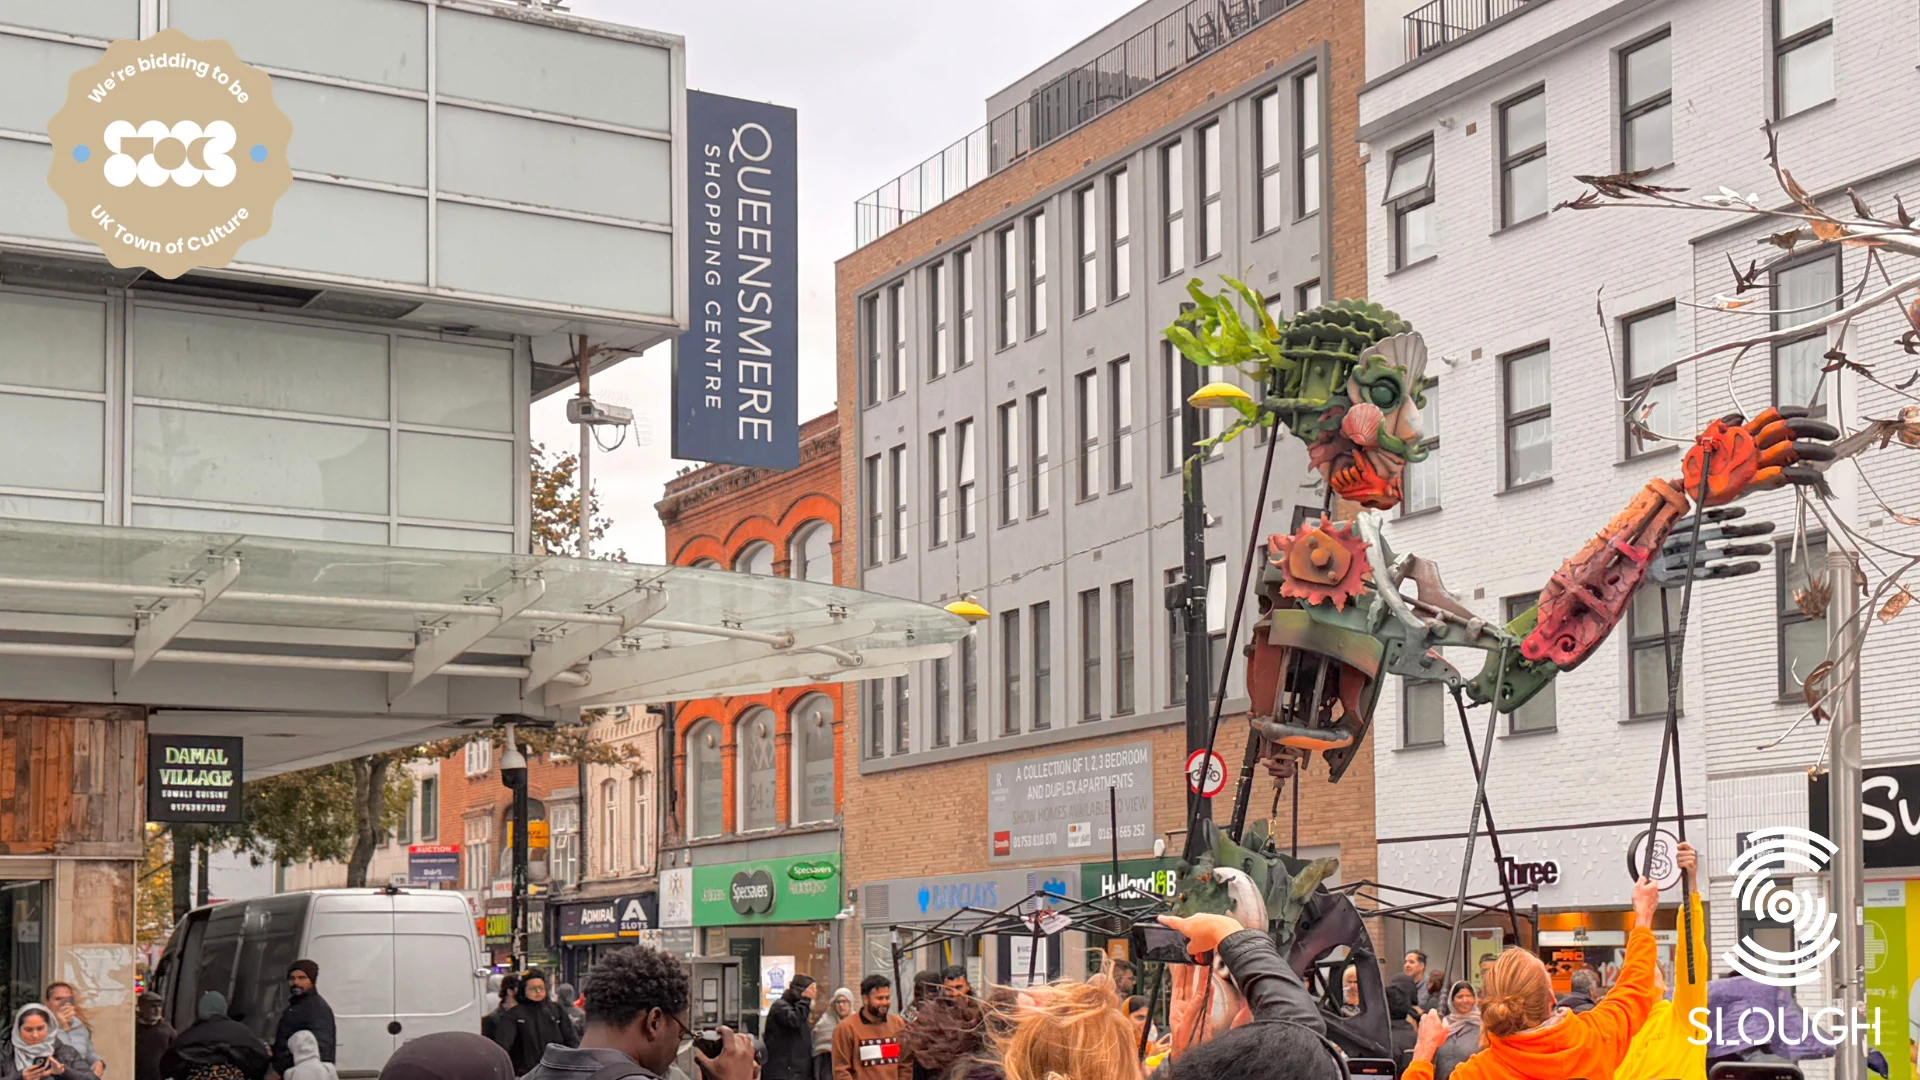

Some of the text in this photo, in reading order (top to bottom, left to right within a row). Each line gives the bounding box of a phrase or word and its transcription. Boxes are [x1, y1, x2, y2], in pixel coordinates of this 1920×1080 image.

[704, 144, 722, 409] SHOPPING CENTRE
[729, 122, 773, 443] QUEENSMERE
[165, 747, 229, 765] DAMAL
[1015, 767, 1022, 782] A
[1023, 762, 1072, 780] COLLECTION
[1073, 759, 1083, 773] OF
[1099, 755, 1104, 769] 3
[1105, 748, 1148, 768] BEDROOM
[159, 769, 234, 787] VILLAGE
[1027, 773, 1133, 800] AND DUPLEX APARTMENTS
[161, 790, 229, 799] SOMALI CUISINE
[1012, 810, 1036, 825] SHOW
[1038, 805, 1067, 823] HOMES
[1068, 800, 1110, 819] AVAILABLE
[1124, 796, 1148, 812] VIEW
[416, 845, 452, 853] AUCTION
[1013, 834, 1031, 849] 01753
[793, 865, 832, 875] Specsavers
[732, 883, 768, 902] Specsavers
[932, 880, 998, 911] BARCLAYS
[580, 907, 616, 925] ADMIRAL
[621, 899, 648, 921] A
[620, 922, 648, 930] SLOTS
